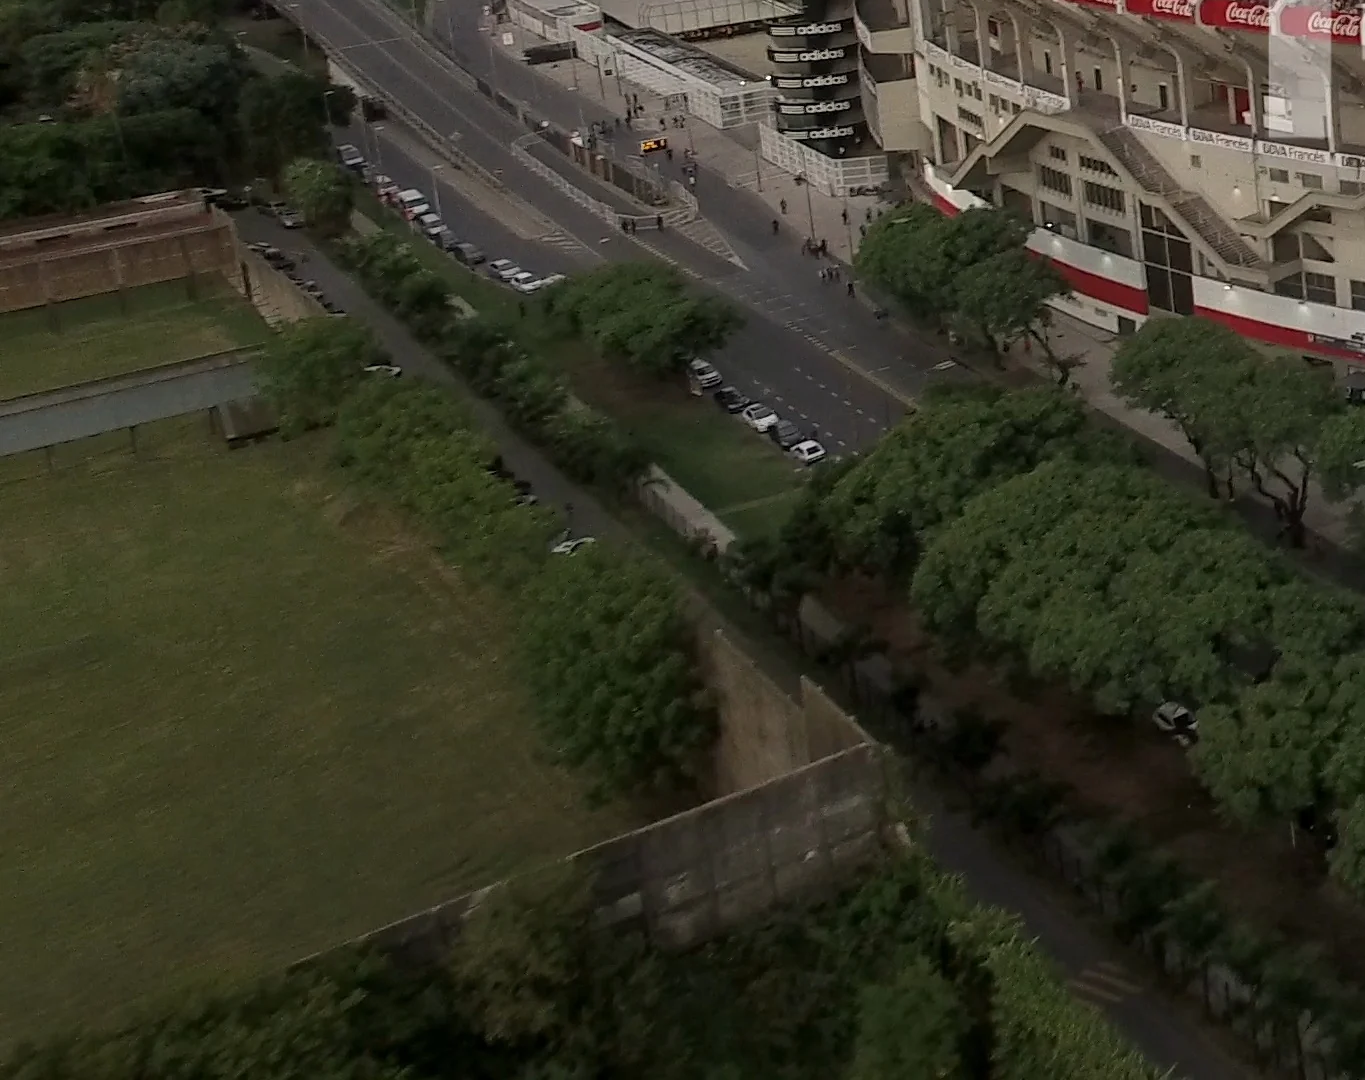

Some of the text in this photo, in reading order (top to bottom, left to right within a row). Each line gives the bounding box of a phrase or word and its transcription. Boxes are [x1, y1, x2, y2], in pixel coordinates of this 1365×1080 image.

[797, 23, 842, 35] adidas
[800, 49, 844, 61] adidas
[803, 75, 848, 87] adidas
[805, 101, 850, 113] adidas
